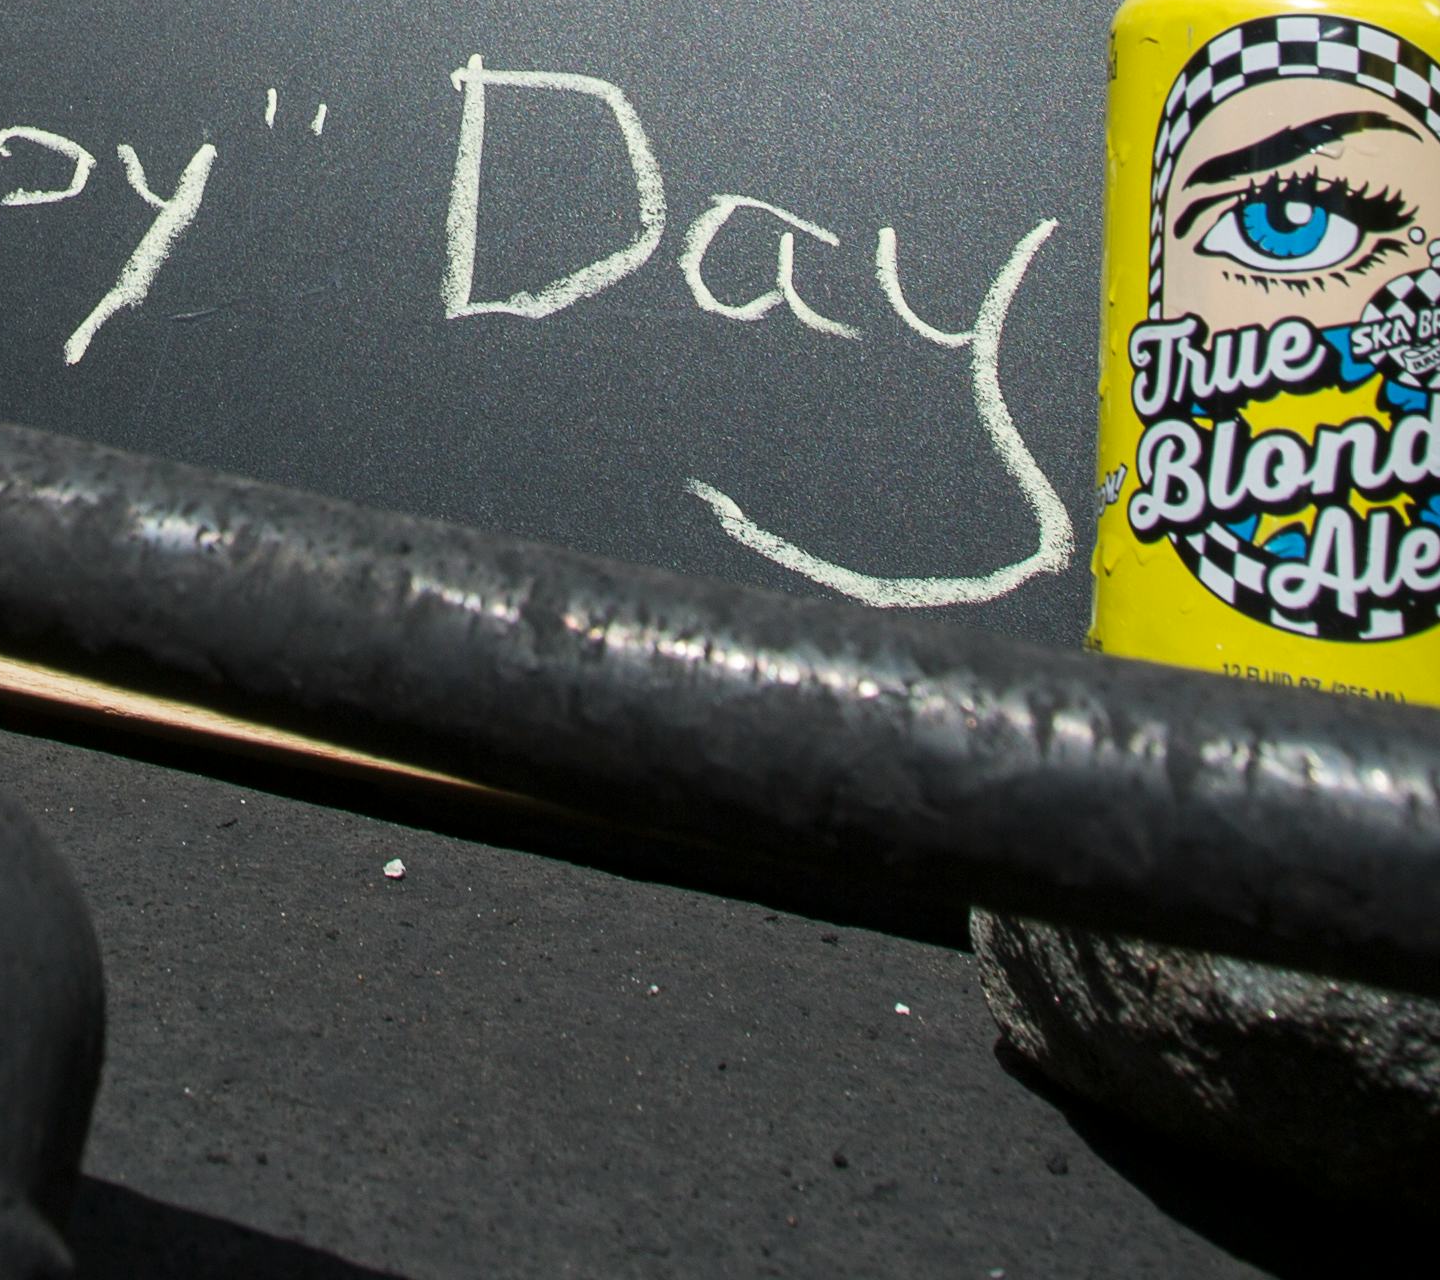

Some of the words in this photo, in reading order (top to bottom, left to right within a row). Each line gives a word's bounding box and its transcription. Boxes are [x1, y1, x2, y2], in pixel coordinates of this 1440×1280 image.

[450, 51, 1075, 609] Day
[1128, 316, 1327, 416] True
[1351, 319, 1411, 355] SKA
